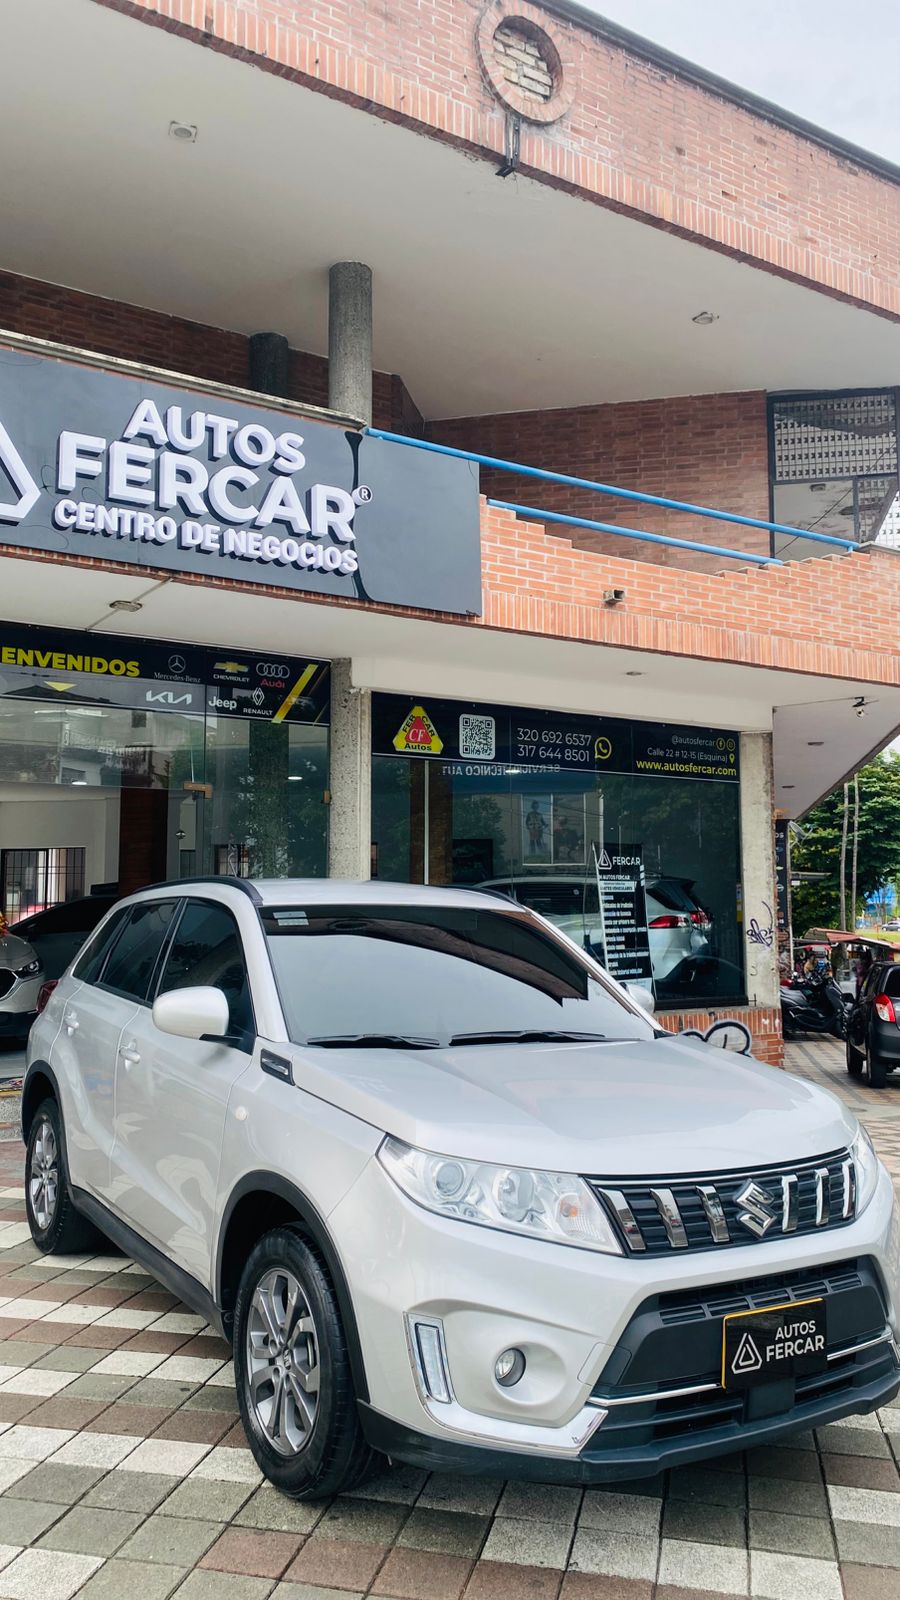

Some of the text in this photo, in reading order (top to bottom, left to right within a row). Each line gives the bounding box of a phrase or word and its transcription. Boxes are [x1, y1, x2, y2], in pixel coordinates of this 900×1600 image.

[123, 399, 306, 474] AUTOS
[57, 430, 357, 542] FERCAR
[54, 498, 358, 575] CENTRO DE NEGOCIOS
[153, 671, 201, 683] Mercedes-Benz
[212, 673, 250, 683] CHEVROLET
[260, 678, 286, 689] Audi
[208, 696, 238, 711] Jeep
[243, 707, 274, 716] RENAULT
[402, 714, 436, 737] FER CAR
[516, 727, 592, 747] 320 692 6537
[671, 734, 715, 747] @autosfercar
[404, 743, 433, 751] Autos
[516, 744, 590, 762] 317 644 8501
[647, 747, 665, 757] Calle
[665, 749, 674, 758] 22
[697, 751, 728, 763] (Esquina)
[635, 760, 737, 776] www.autosfercar.com
[612, 856, 641, 866] FERCAR
[775, 1319, 816, 1341] AUTOS
[766, 1335, 825, 1362] FERCAR
